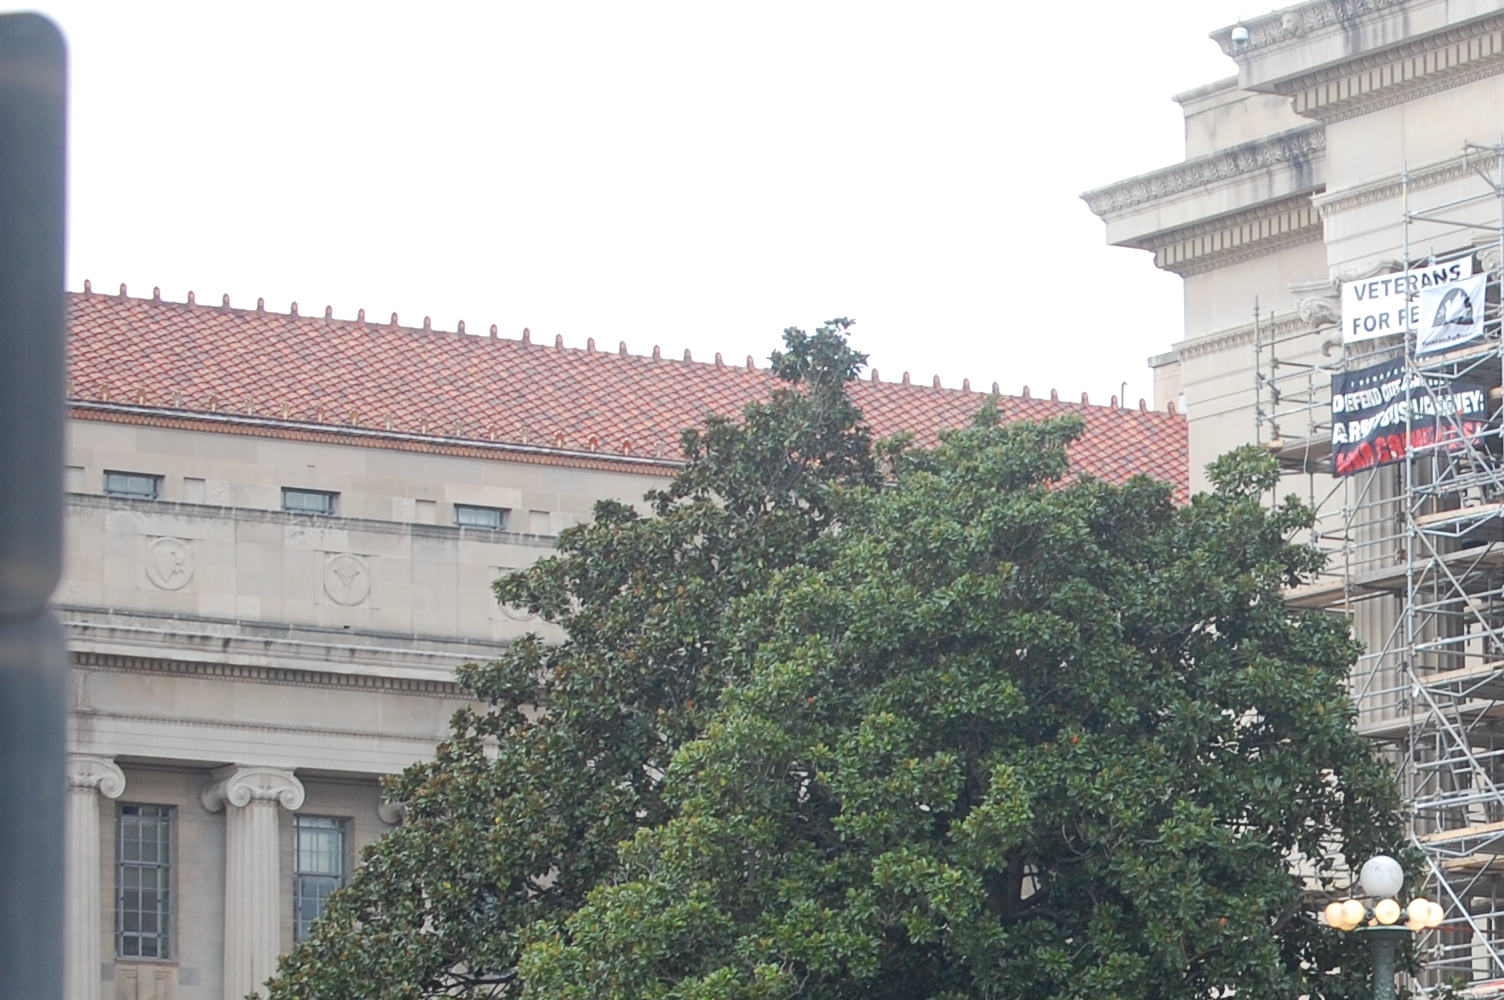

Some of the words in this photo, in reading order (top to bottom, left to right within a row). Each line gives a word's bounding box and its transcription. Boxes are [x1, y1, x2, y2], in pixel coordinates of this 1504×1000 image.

[1354, 264, 1461, 301] VETERANS
[1353, 312, 1390, 335] FOR
[1333, 387, 1382, 413] DEFEND
